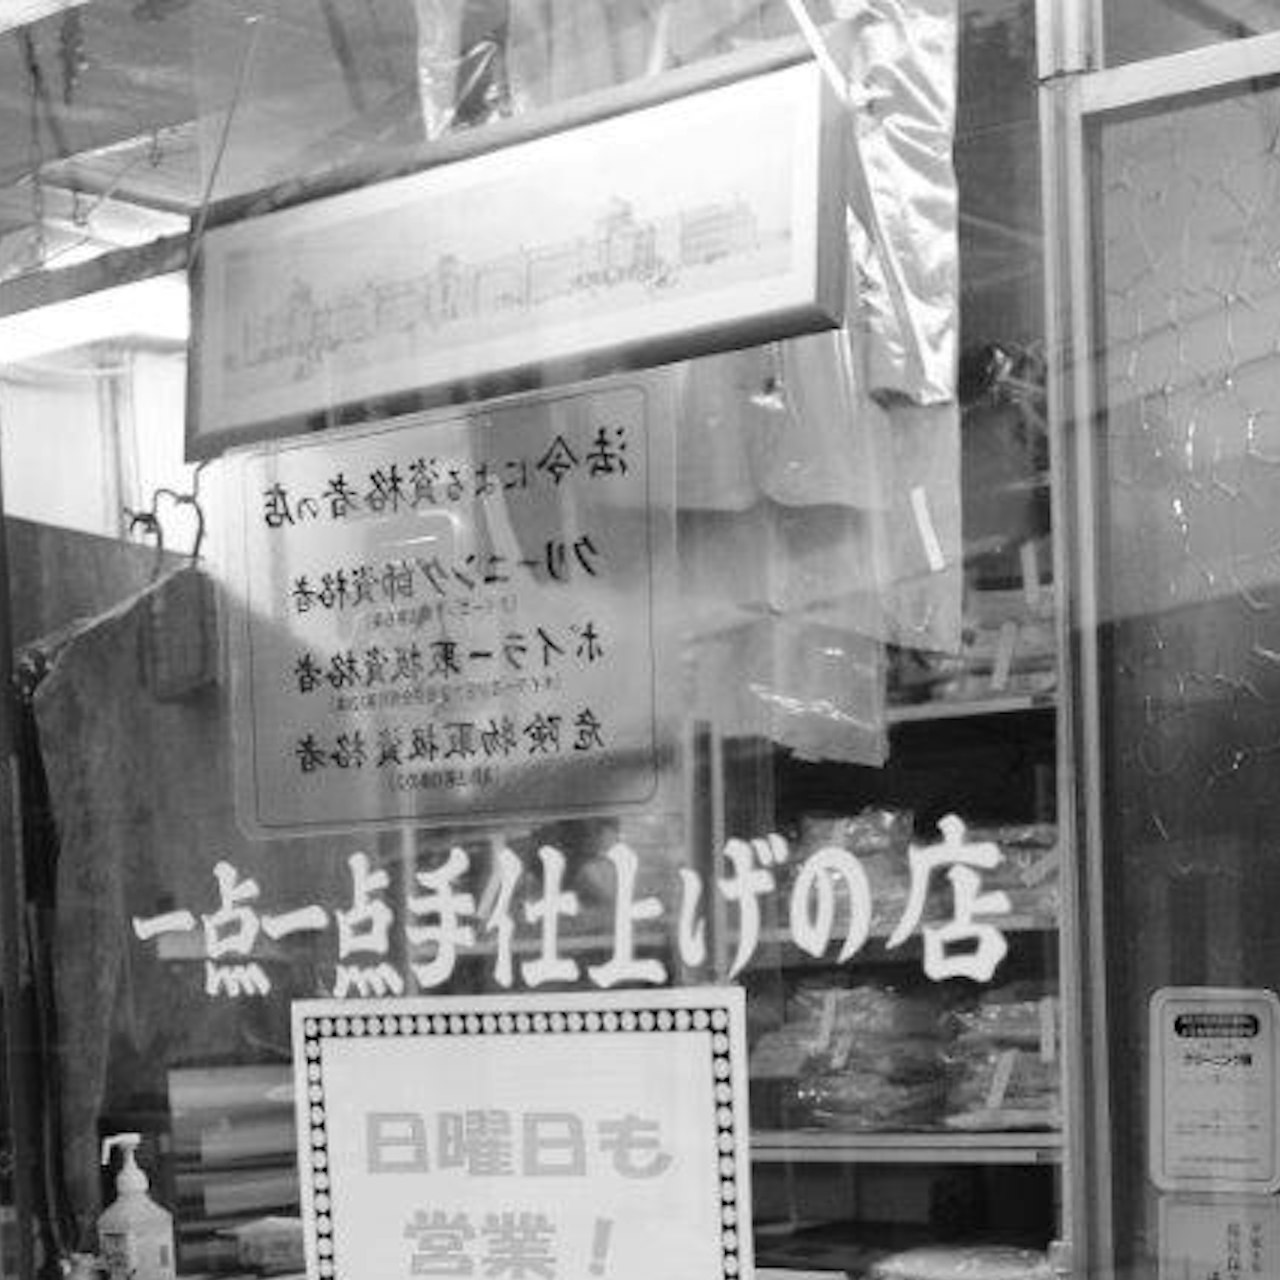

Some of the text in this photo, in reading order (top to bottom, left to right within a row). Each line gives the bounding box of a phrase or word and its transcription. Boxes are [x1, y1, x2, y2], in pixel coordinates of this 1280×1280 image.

[133, 814, 1010, 997] 一点一点手仕上げの店
[364, 1109, 671, 1178] 日曜日も
